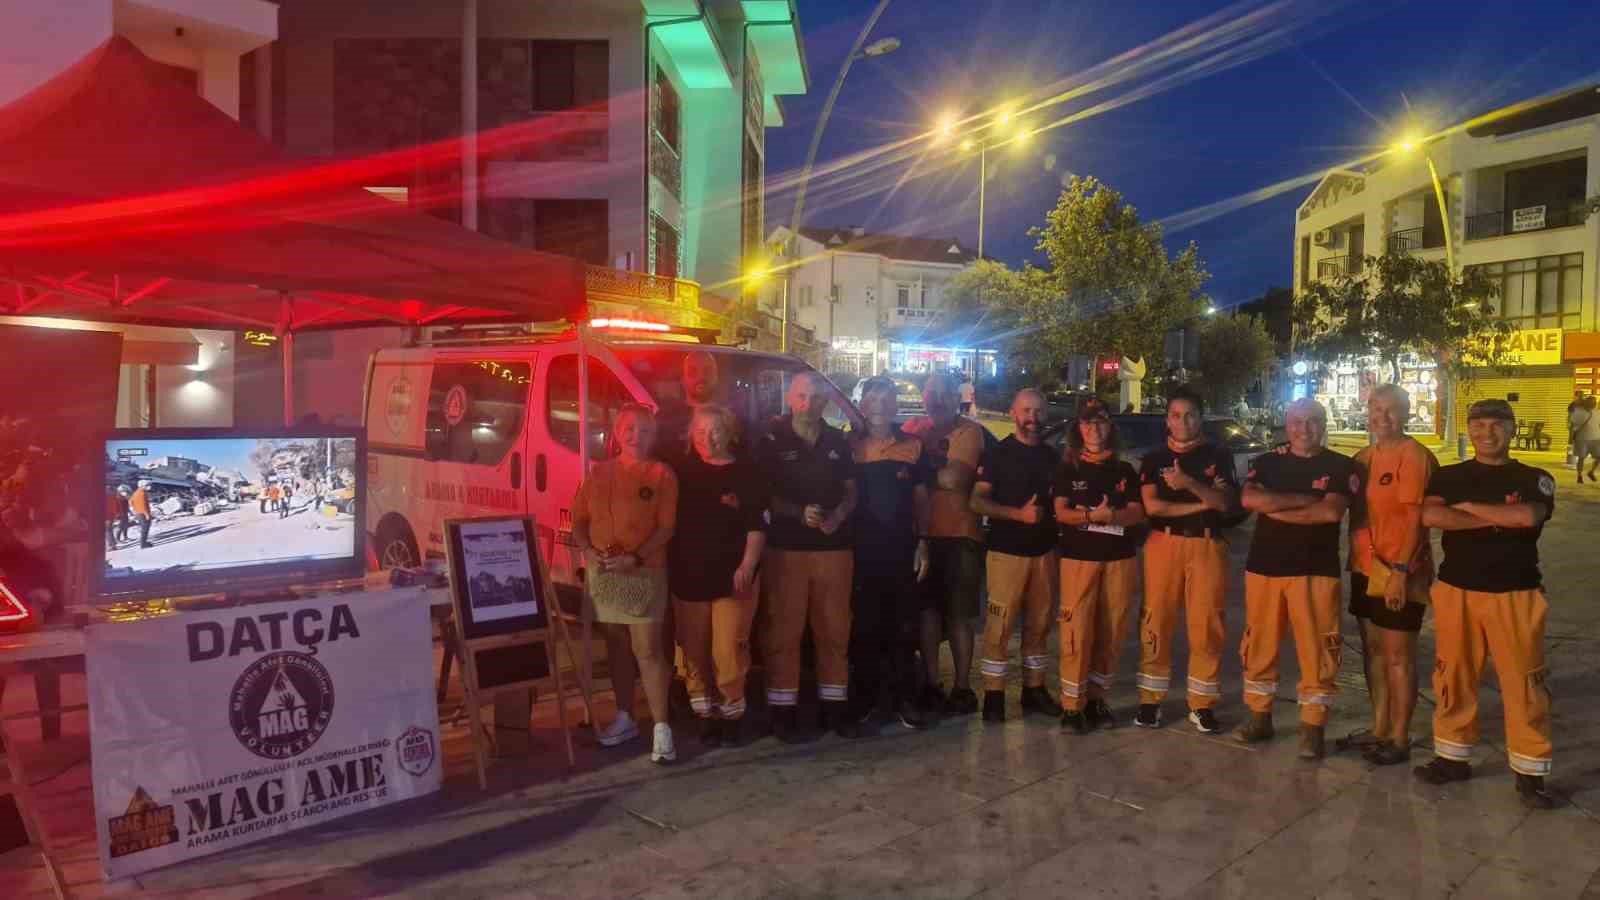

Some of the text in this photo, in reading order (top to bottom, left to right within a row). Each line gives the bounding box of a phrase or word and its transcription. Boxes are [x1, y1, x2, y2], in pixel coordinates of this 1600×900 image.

[186, 604, 361, 663] DATÇA
[258, 706, 309, 740] MAG
[184, 753, 387, 836] MAG AME
[187, 831, 230, 848] ARAMA
[290, 801, 329, 821] SEARCH
[330, 797, 351, 810] AND
[351, 786, 387, 804] RESCUE
